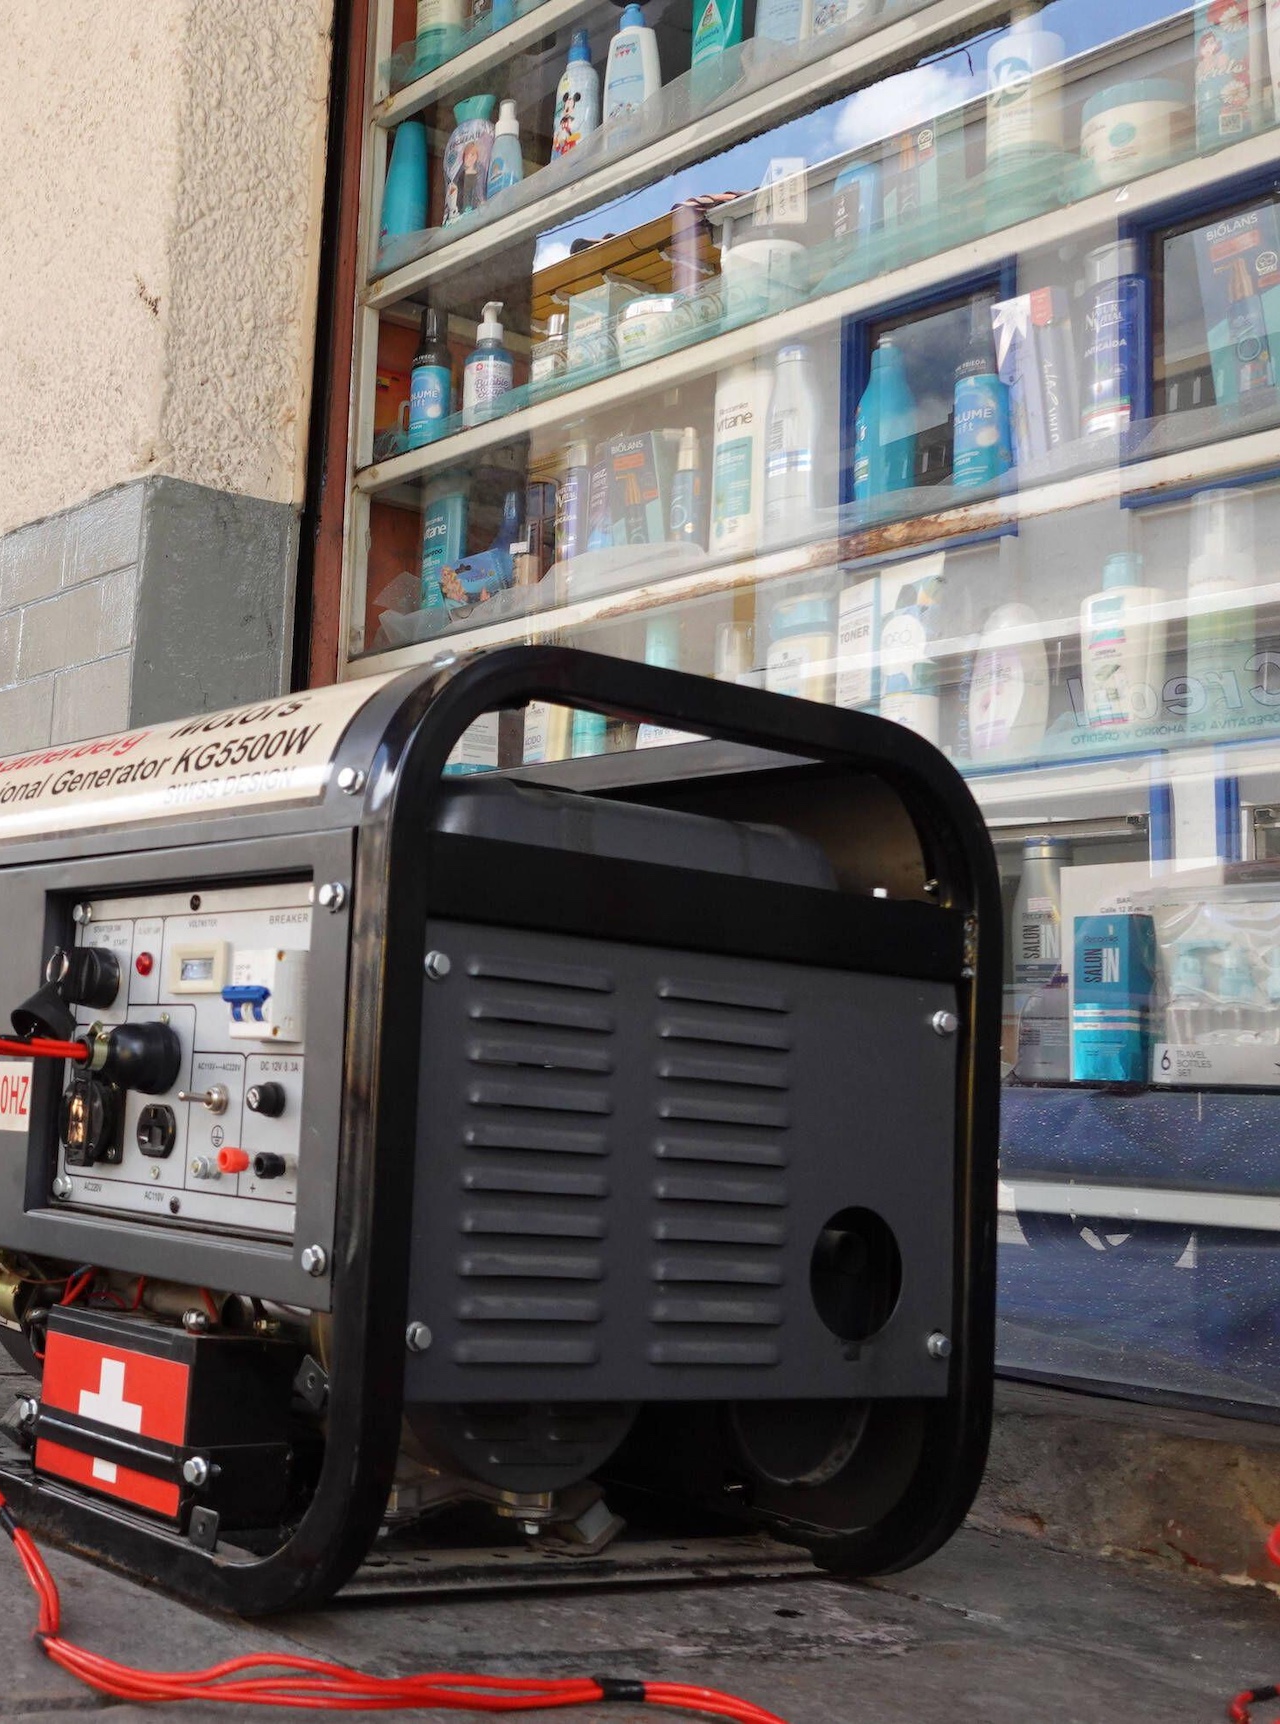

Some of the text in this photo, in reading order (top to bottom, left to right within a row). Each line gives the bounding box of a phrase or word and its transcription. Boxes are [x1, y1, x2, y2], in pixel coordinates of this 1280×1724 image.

[840, 625, 870, 645] TONER
[169, 697, 312, 740] Motors
[51, 757, 173, 797] Generator
[172, 723, 322, 776] KG5500W
[164, 766, 297, 804] SWISS DESIGN
[269, 913, 309, 925] BREAKER
[1023, 924, 1060, 959] SALON IN
[1084, 948, 1120, 983] SALON IN
[1161, 1050, 1171, 1071] 6
[1176, 1050, 1207, 1059] TRAVEL
[1177, 1060, 1212, 1068] BOTTLES
[260, 1061, 269, 1071] DC
[271, 1061, 282, 1071] 12V
[1177, 1069, 1191, 1077] SET
